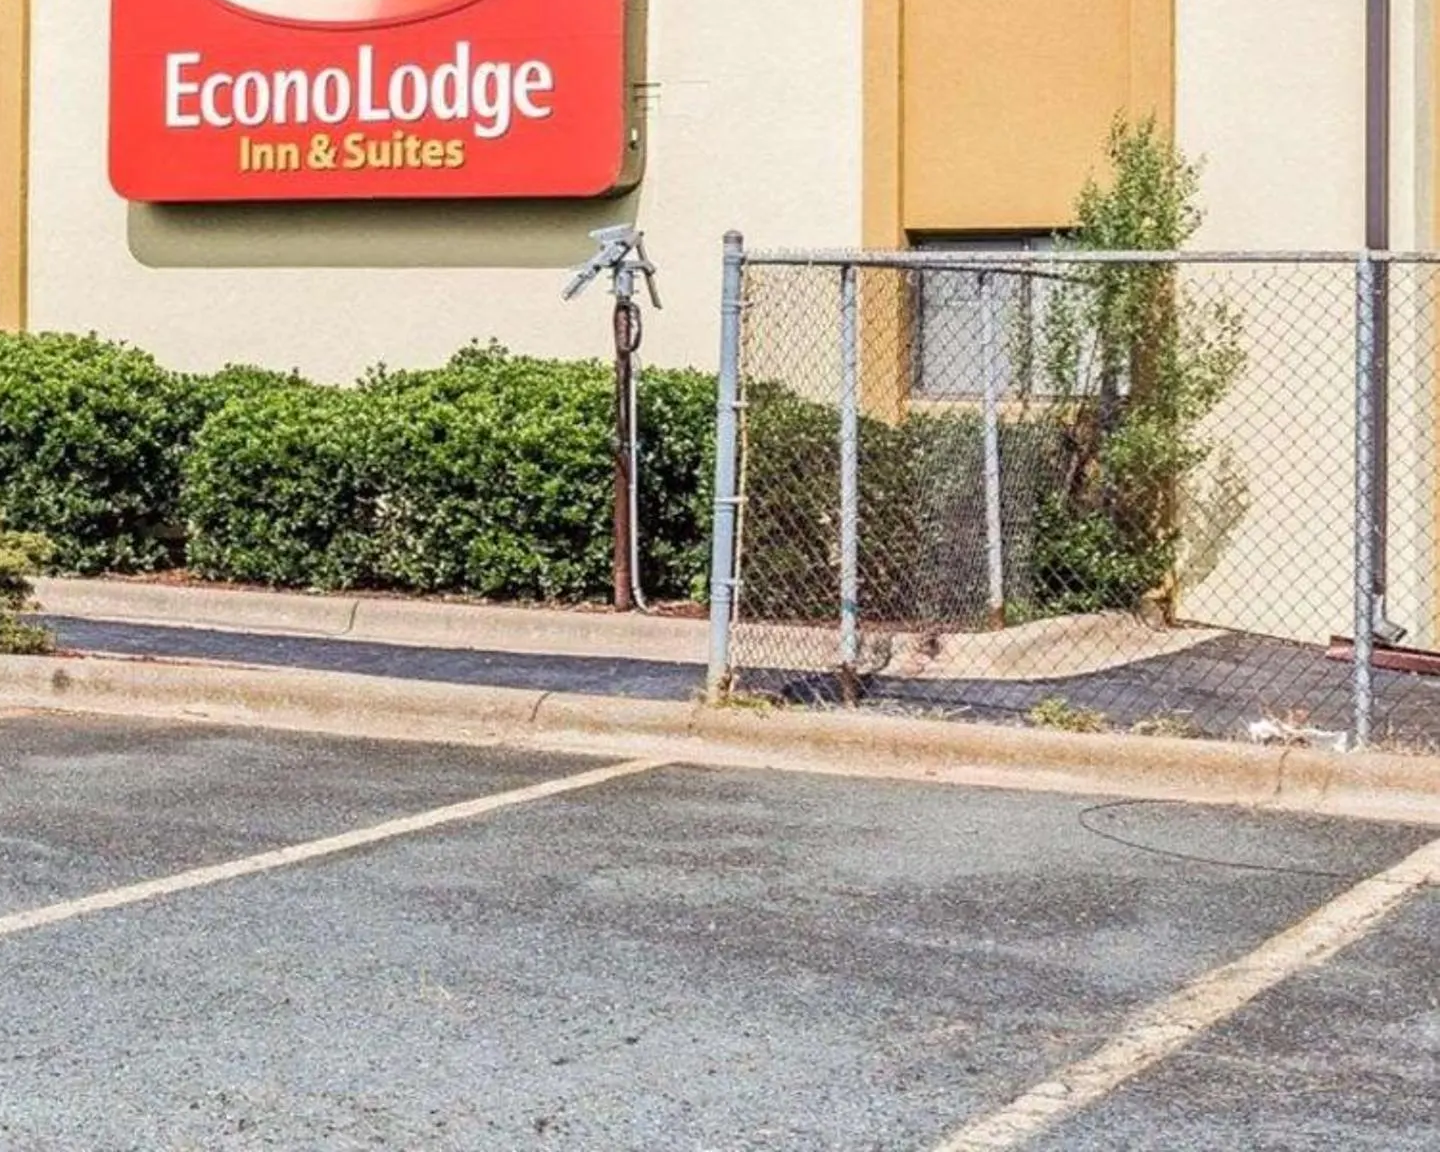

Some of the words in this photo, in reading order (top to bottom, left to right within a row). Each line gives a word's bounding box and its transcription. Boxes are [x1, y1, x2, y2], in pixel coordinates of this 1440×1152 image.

[239, 137, 300, 171] Inn
[306, 133, 337, 170] &
[341, 130, 466, 169] Suites
